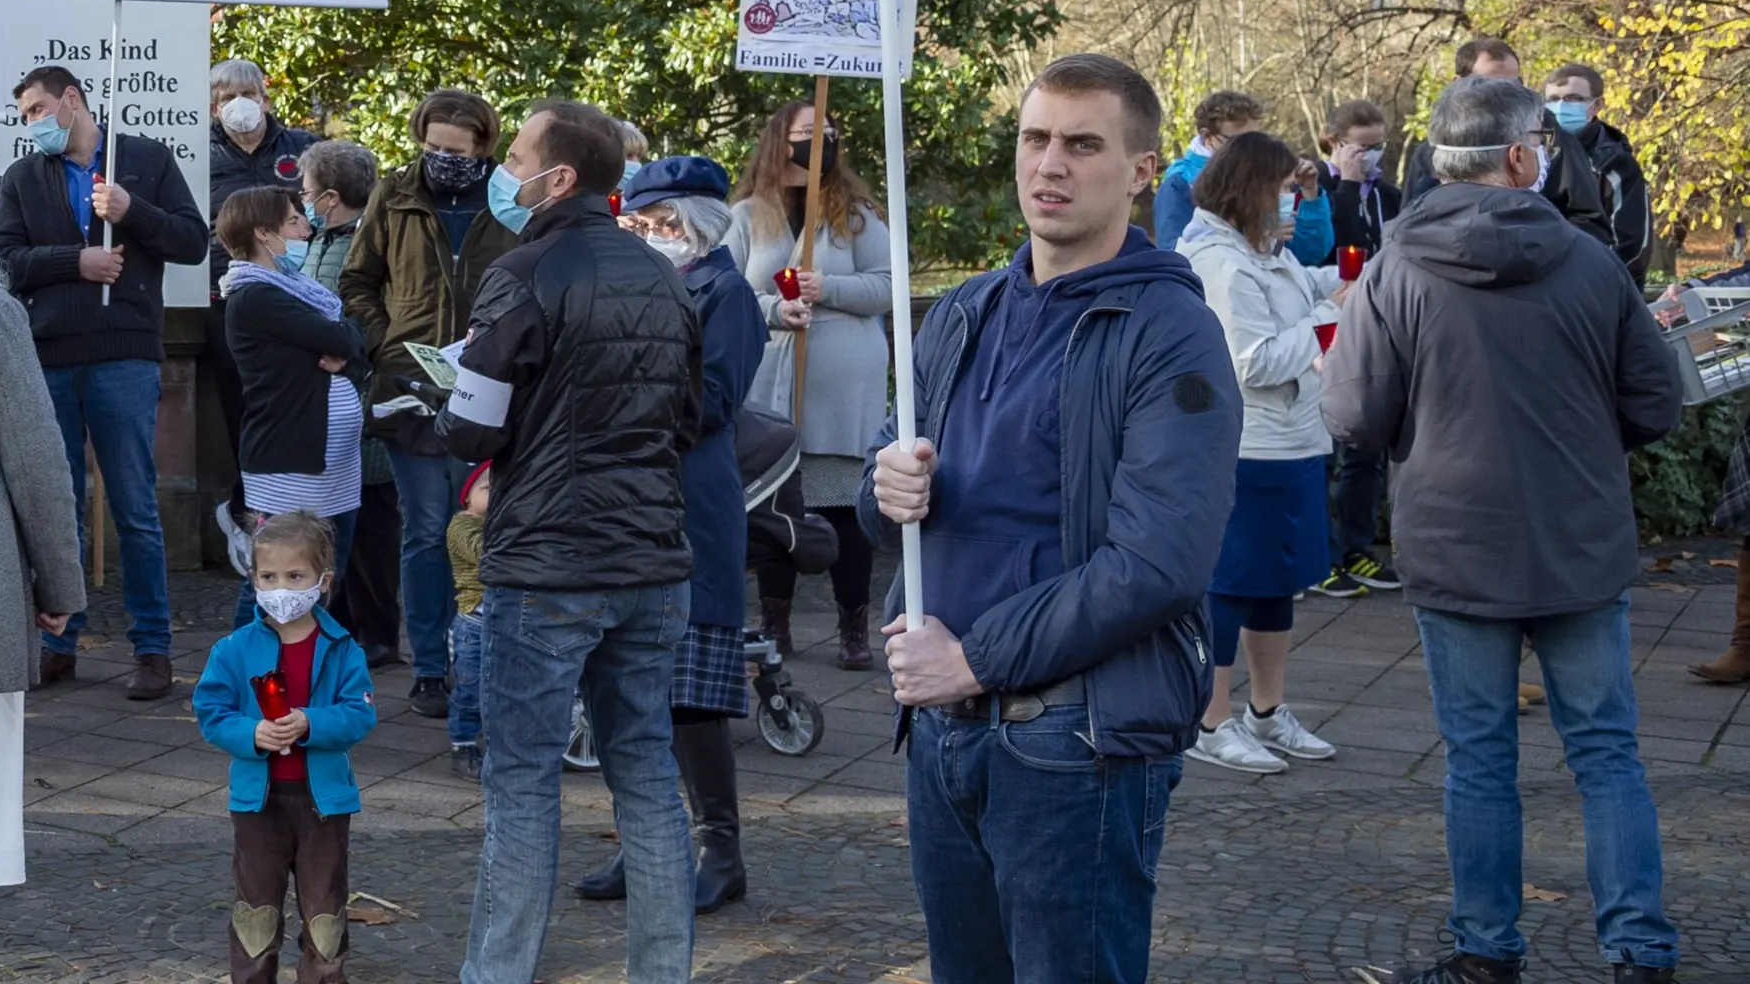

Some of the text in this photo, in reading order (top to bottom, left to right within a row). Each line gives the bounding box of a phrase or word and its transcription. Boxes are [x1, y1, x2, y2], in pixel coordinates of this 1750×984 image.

[98, 38, 158, 61] Kind
[739, 50, 807, 69] Familie
[102, 71, 177, 98] größte
[122, 104, 197, 126] Gottes
[11, 137, 33, 159] fü
